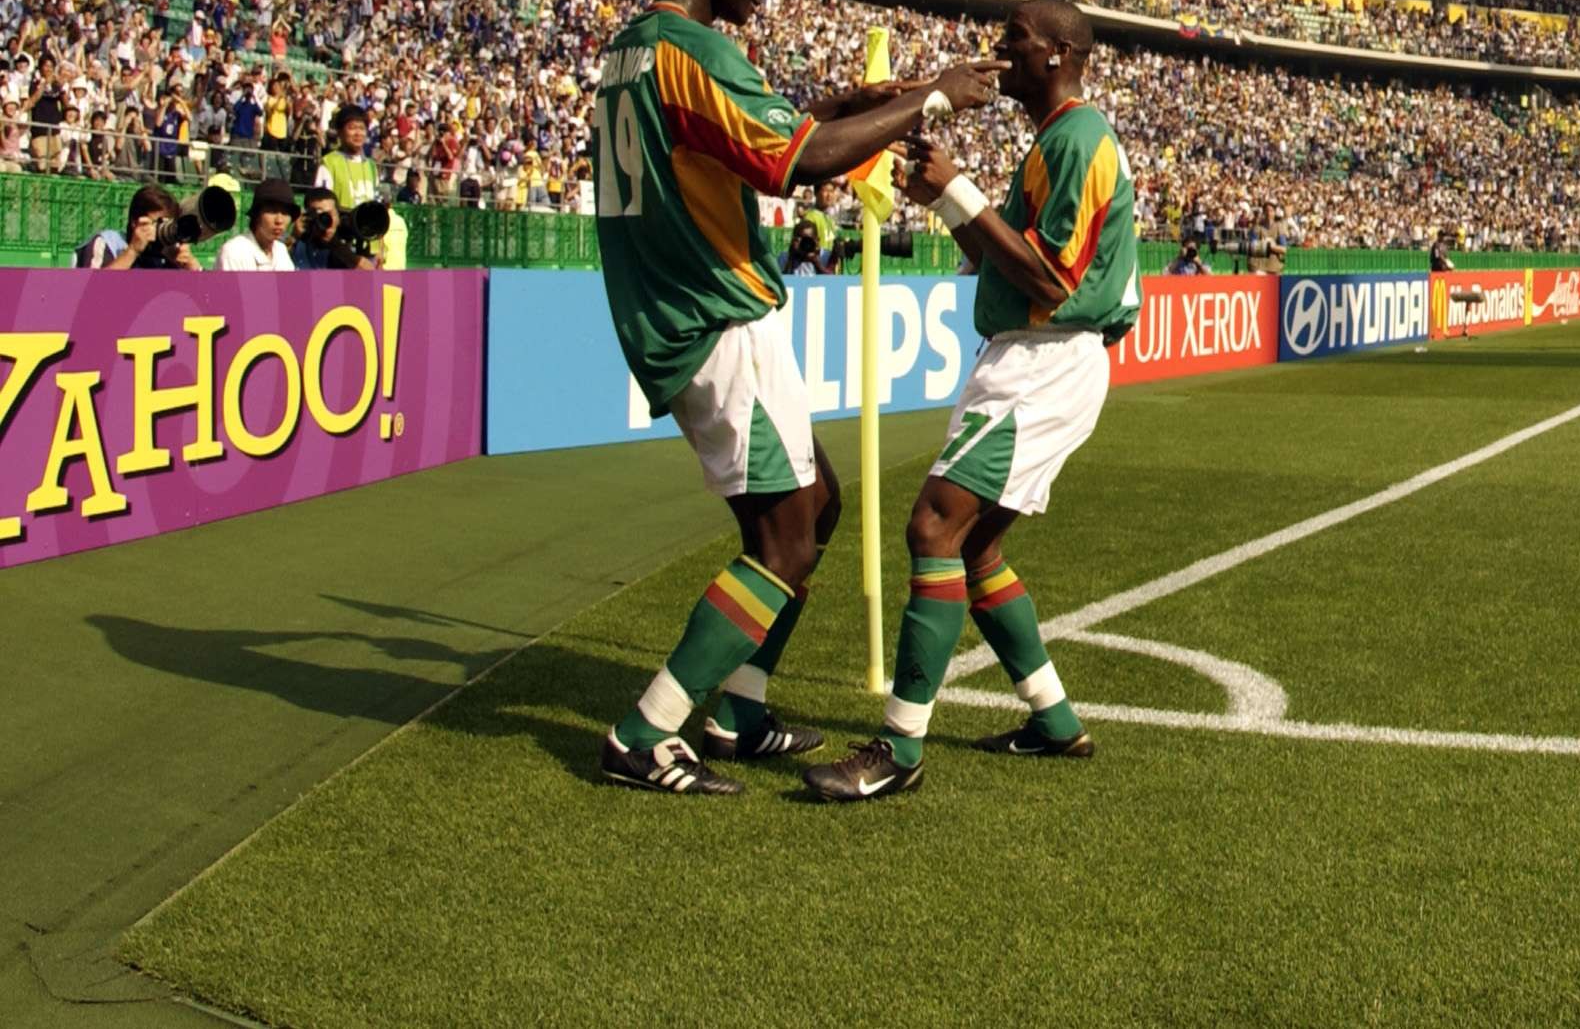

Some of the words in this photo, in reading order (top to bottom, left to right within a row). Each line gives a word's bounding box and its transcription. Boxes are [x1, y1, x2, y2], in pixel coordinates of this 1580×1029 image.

[592, 89, 645, 217] 19
[1181, 290, 1262, 359] XEROX
[1329, 279, 1428, 347] HYUNDAI
[1448, 282, 1525, 328] McDonald's
[629, 283, 961, 429] LIPS
[939, 411, 991, 462] 7
